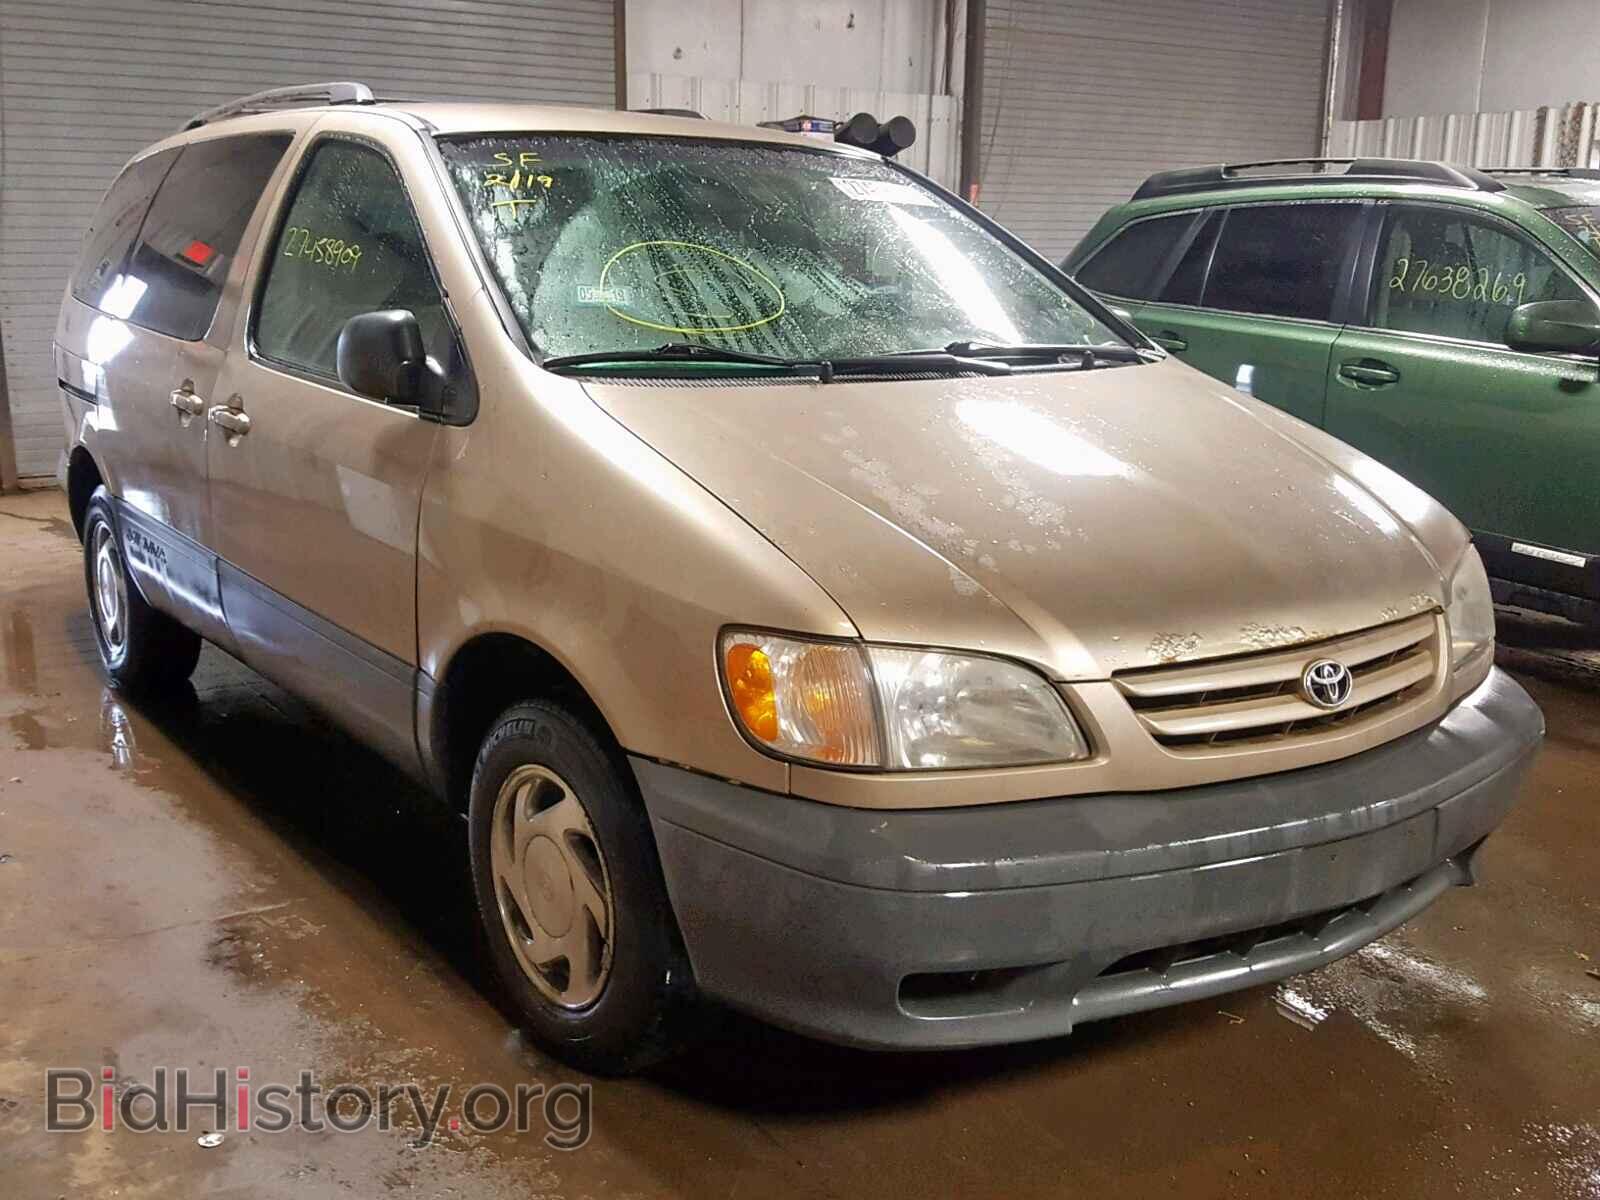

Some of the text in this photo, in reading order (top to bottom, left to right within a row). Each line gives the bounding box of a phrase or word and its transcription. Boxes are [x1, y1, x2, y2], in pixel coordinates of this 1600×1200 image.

[490, 152, 543, 168] SF
[283, 226, 363, 272] 27458909
[1388, 257, 1526, 304] 27638269
